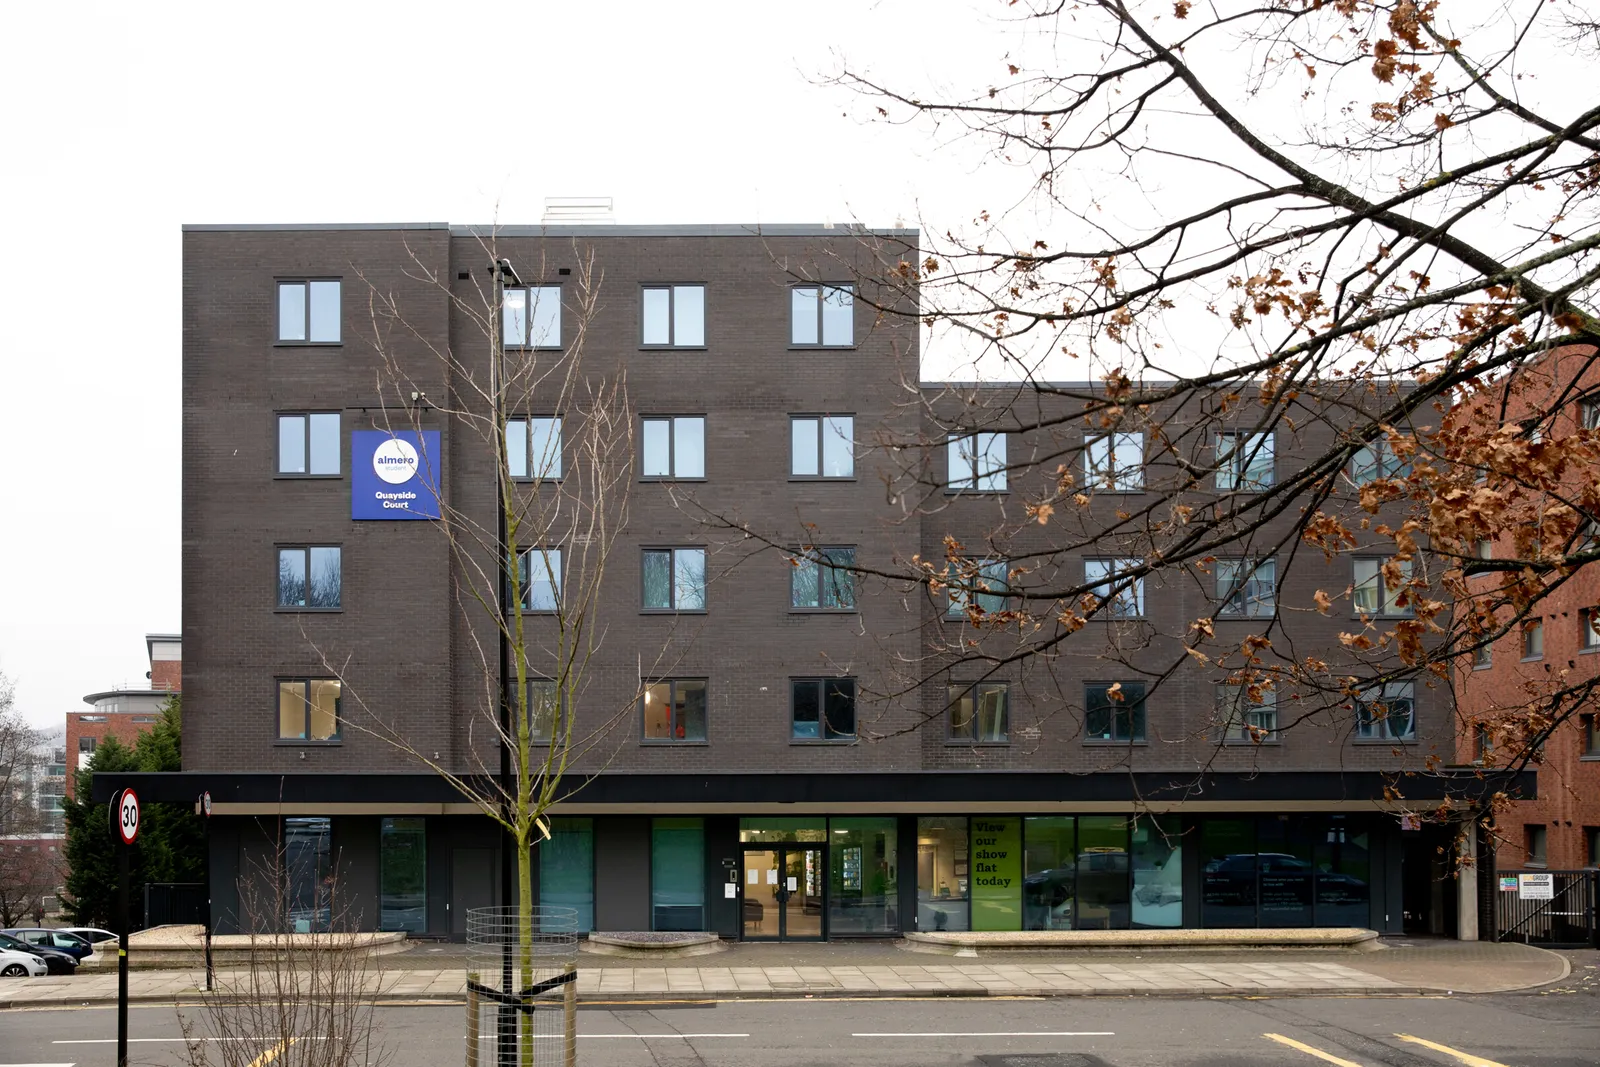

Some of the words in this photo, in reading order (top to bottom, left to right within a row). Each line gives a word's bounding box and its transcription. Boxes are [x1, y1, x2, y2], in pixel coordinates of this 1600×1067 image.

[375, 492, 416, 500] Quayside
[122, 805, 137, 828] 30
[976, 823, 1005, 832] View
[976, 850, 1007, 858] show
[976, 863, 998, 872] flat
[976, 876, 1011, 888] today
